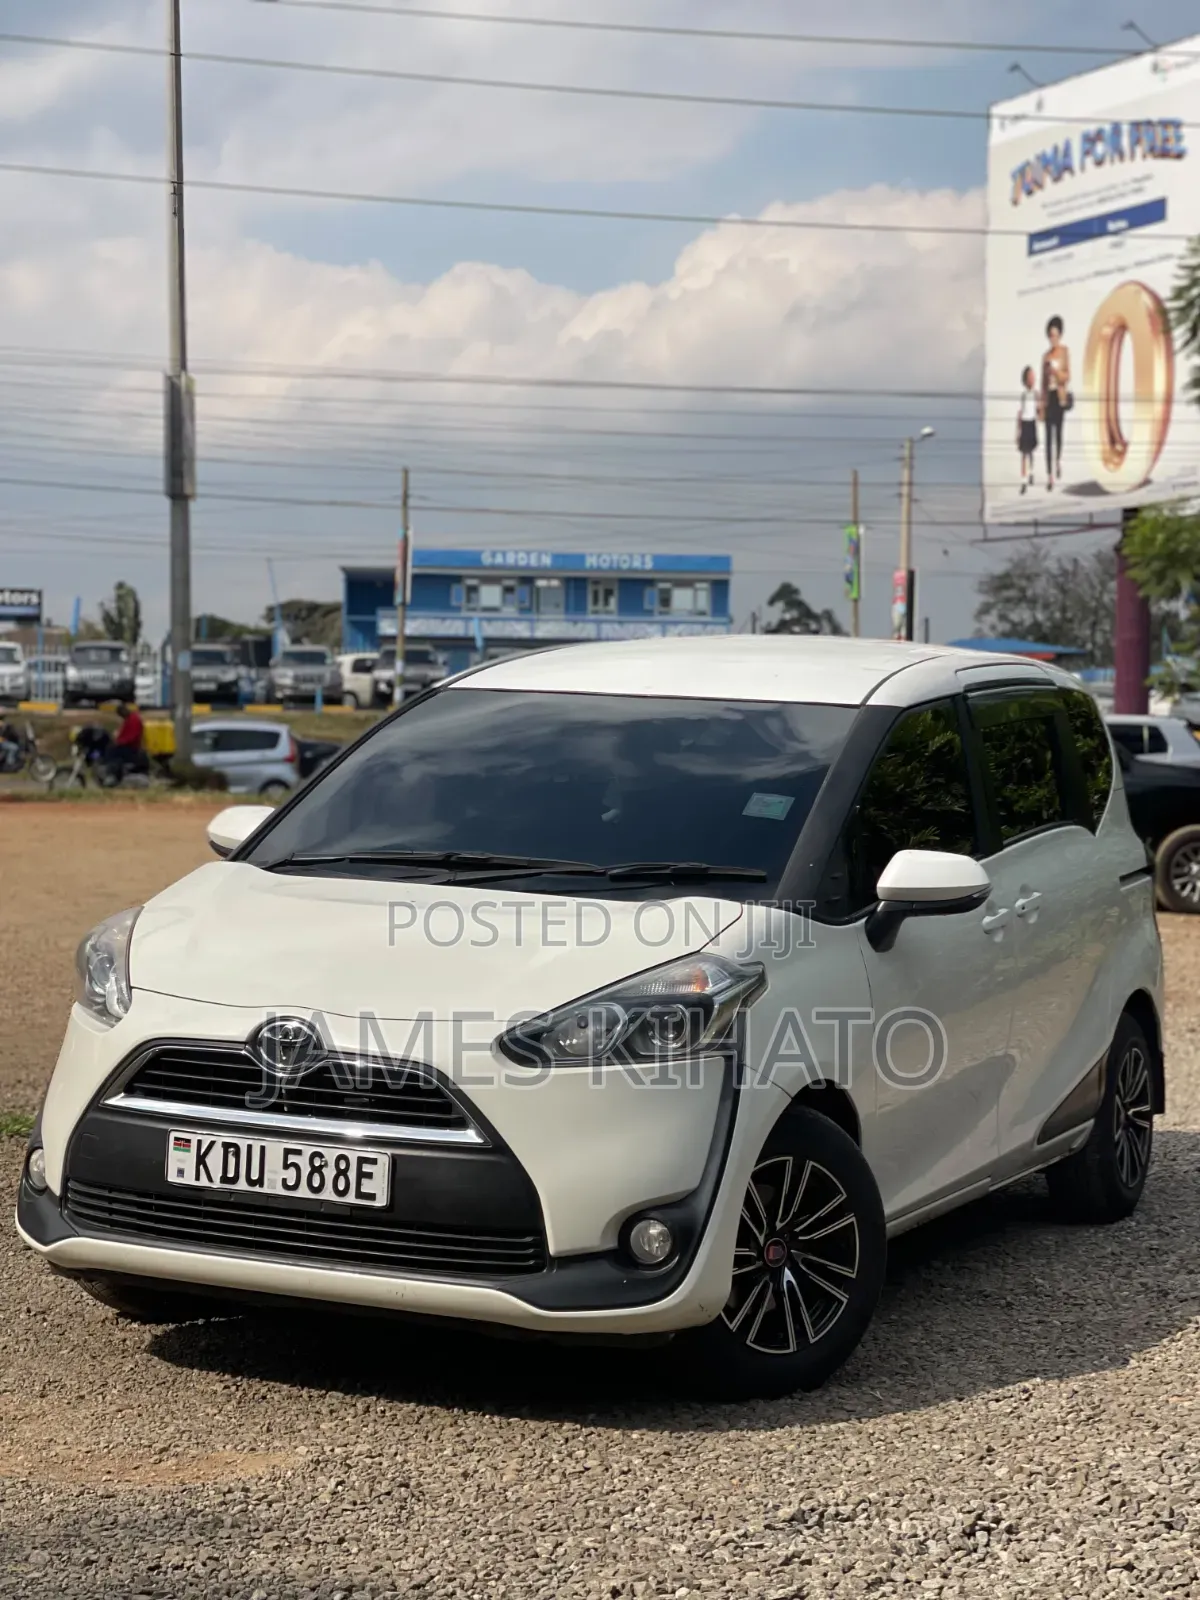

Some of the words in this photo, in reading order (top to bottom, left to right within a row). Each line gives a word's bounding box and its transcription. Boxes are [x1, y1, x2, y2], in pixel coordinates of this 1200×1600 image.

[480, 550, 552, 568] GARDEN
[585, 553, 653, 570] MOTORS
[0, 590, 39, 605] tors
[194, 1139, 266, 1189] KDU
[281, 1147, 378, 1202] 588E
